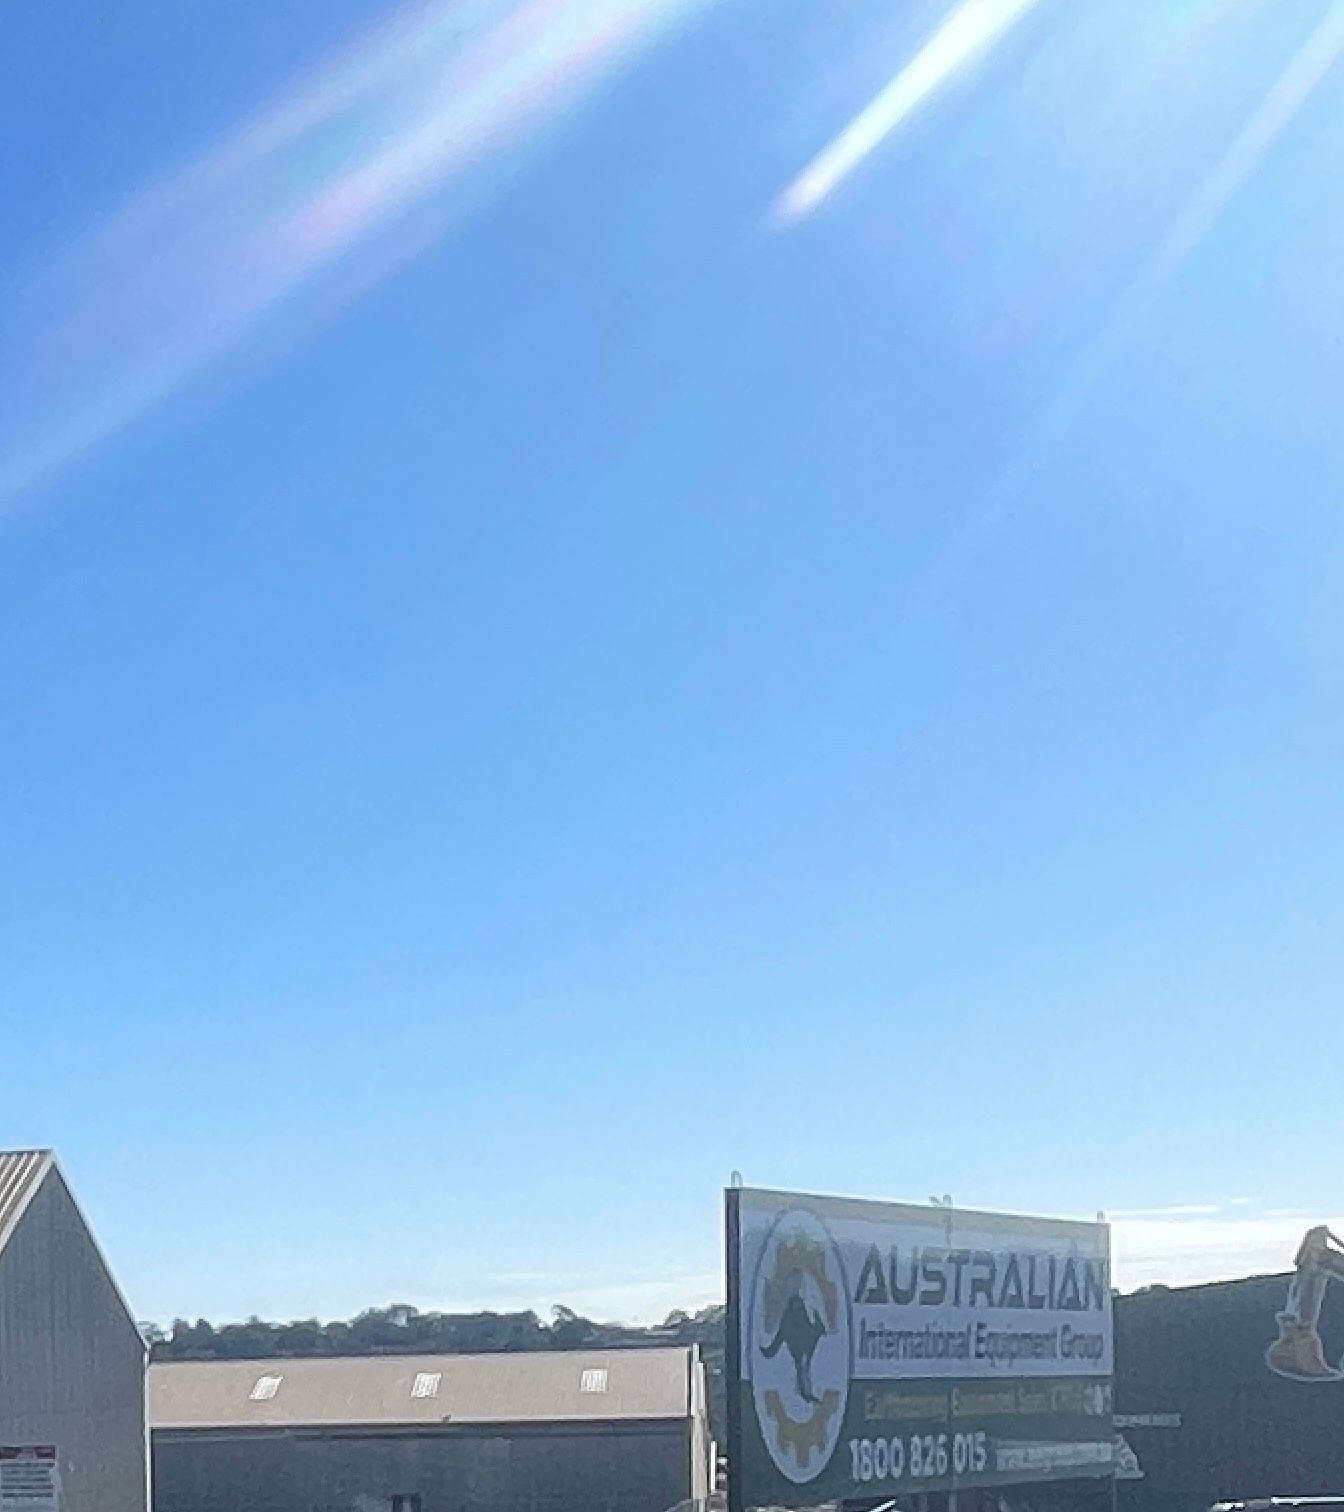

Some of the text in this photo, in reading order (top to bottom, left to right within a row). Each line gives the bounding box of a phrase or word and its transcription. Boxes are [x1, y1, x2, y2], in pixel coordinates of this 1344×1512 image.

[855, 1245, 1104, 1310] AUSTRALIAN
[858, 1318, 1104, 1367] International Equipment Group
[849, 1437, 904, 1482] 1800
[910, 1434, 948, 1478] 826
[953, 1431, 987, 1473] 015
